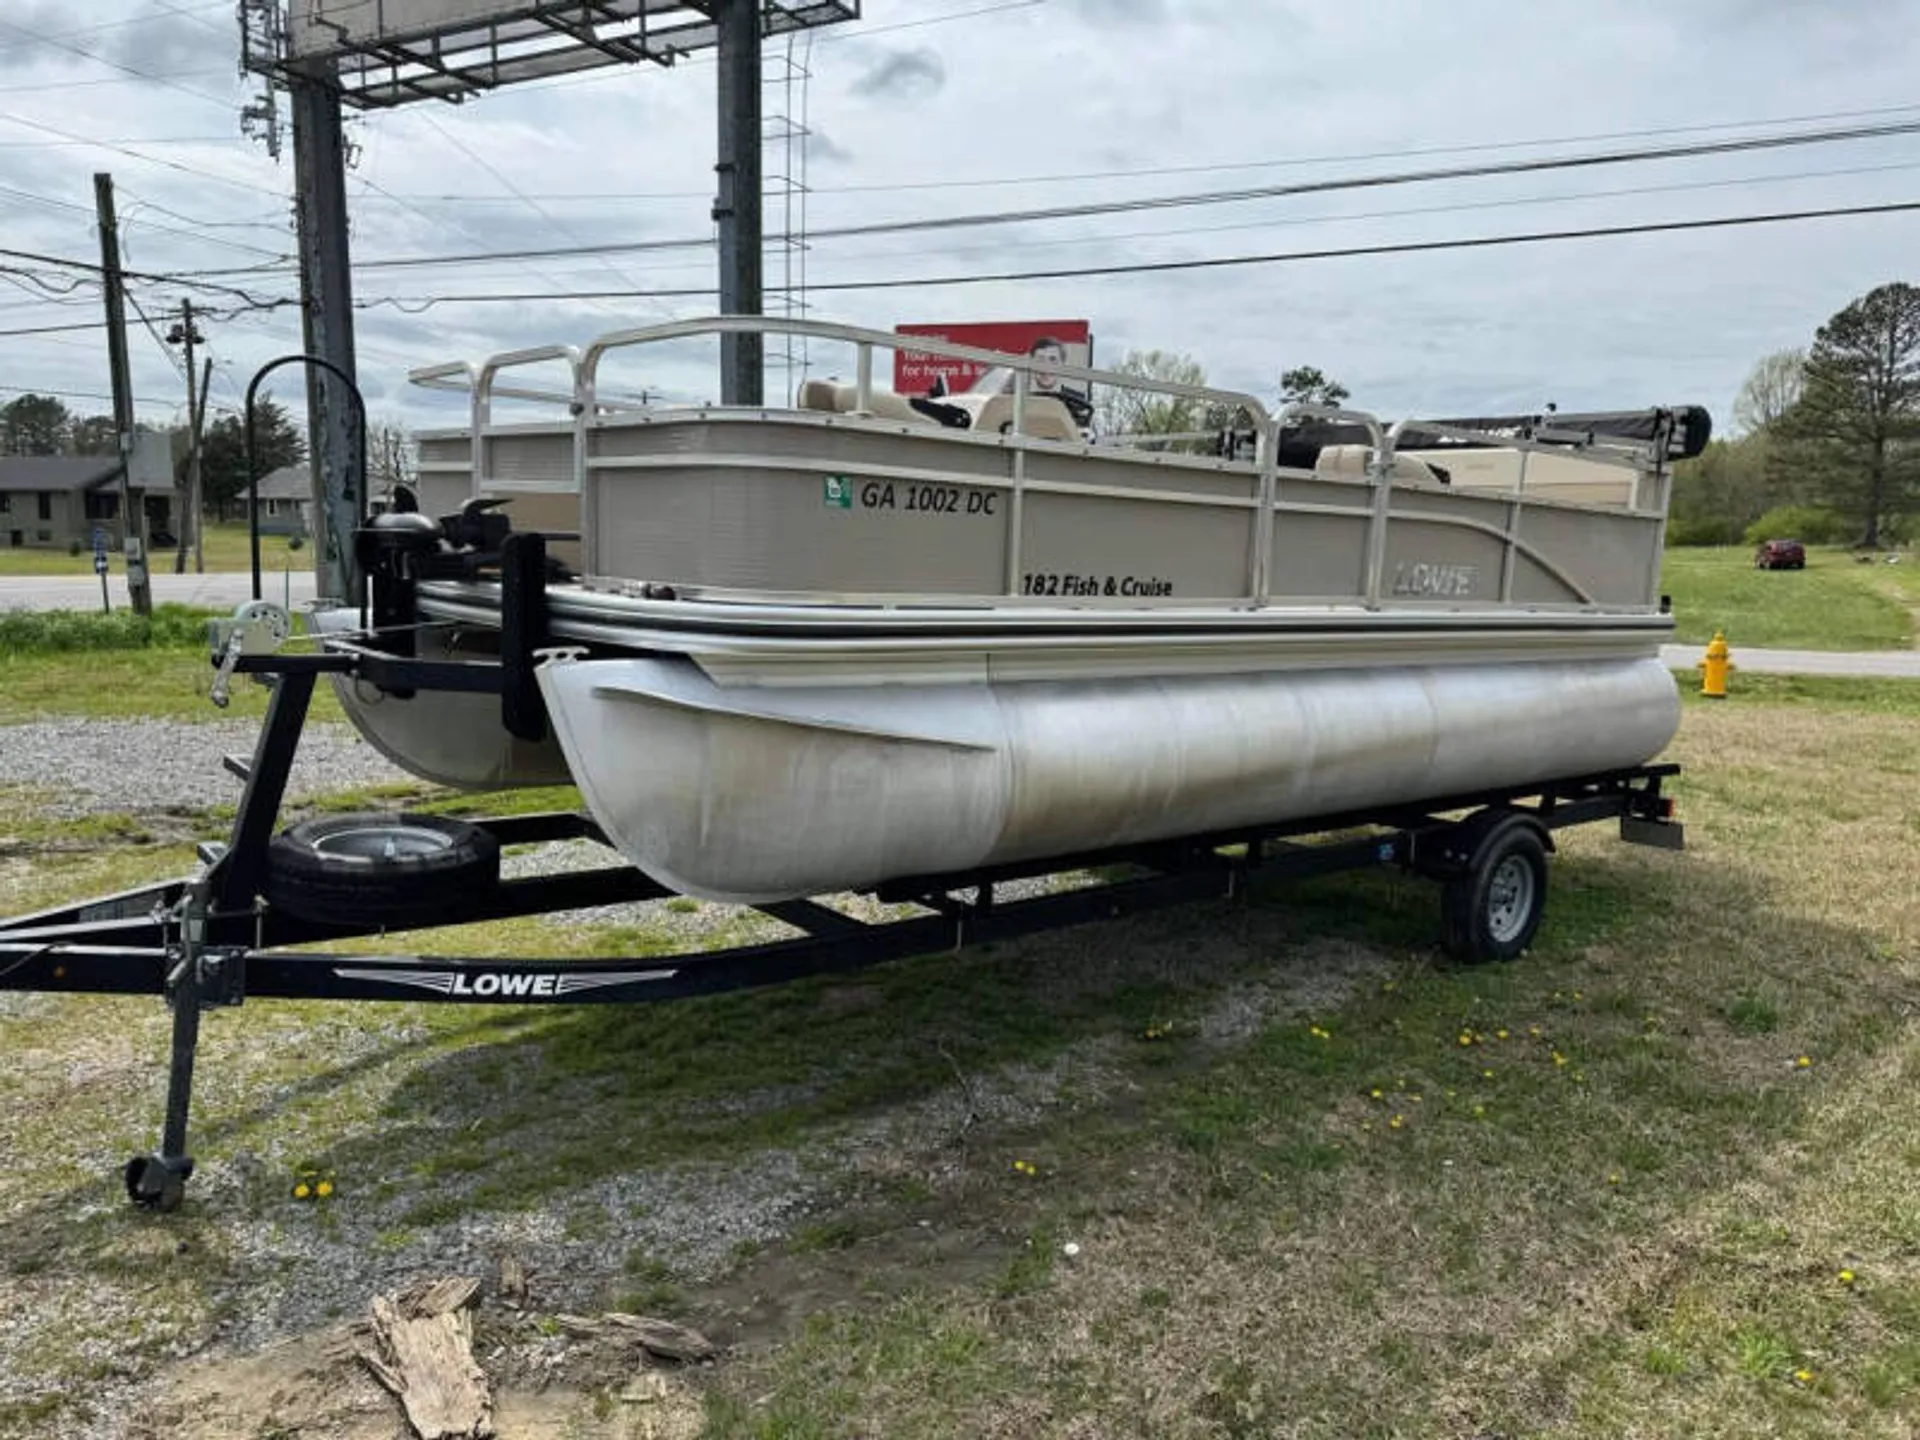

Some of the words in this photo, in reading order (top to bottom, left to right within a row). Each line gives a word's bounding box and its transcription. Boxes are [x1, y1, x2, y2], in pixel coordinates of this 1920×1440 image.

[861, 482, 895, 509] GA
[904, 486, 958, 513] 1002
[966, 491, 999, 515] DC
[1024, 573, 1058, 596] 182
[1062, 574, 1099, 596] Fish
[1103, 576, 1117, 596] &
[1121, 576, 1173, 596] Cruise
[453, 974, 555, 995] LOWE
